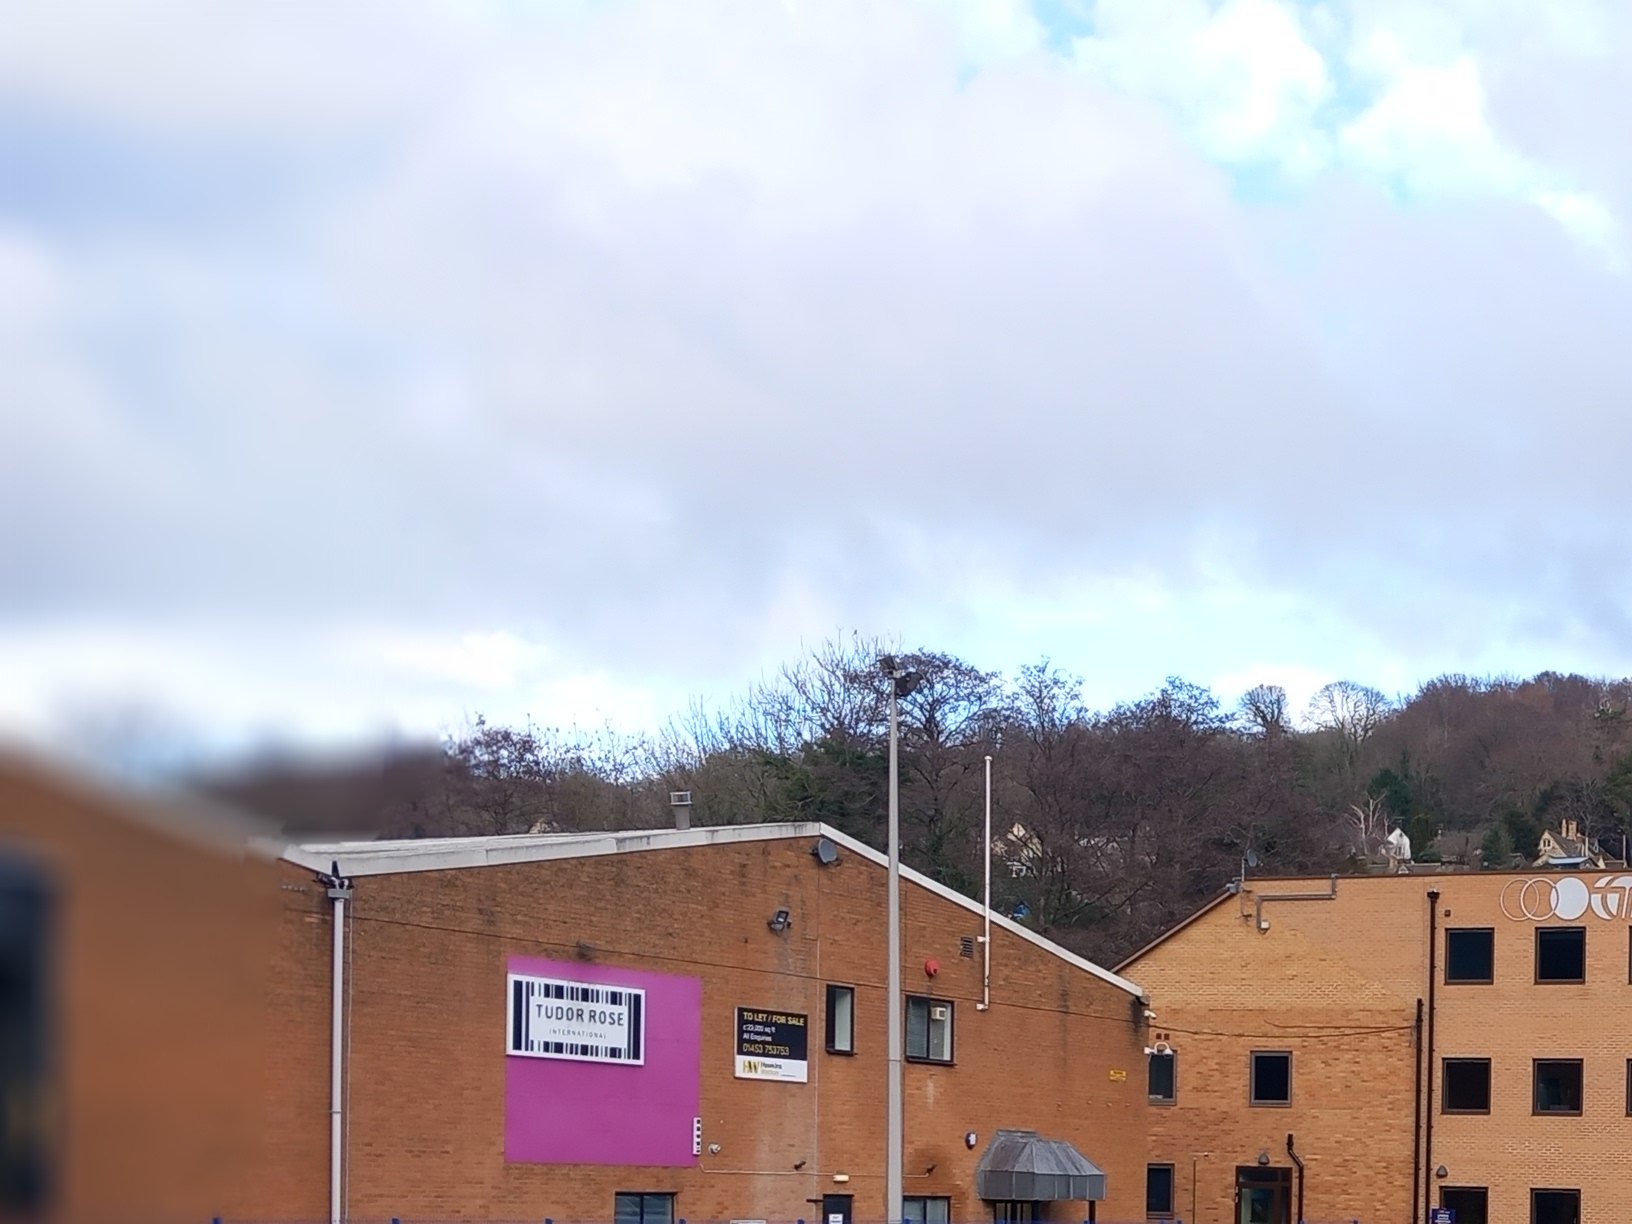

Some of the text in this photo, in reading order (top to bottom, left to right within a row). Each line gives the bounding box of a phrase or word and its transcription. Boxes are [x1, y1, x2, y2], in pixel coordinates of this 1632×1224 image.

[536, 1004, 625, 1027] TUDOR ROSE
[743, 1012, 753, 1020] TO
[754, 1013, 767, 1022] LET
[772, 1015, 786, 1024] FOR
[788, 1016, 804, 1026] SALE
[549, 1028, 607, 1040] INTERNATIONAL
[743, 1043, 789, 1055] 01453 753753
